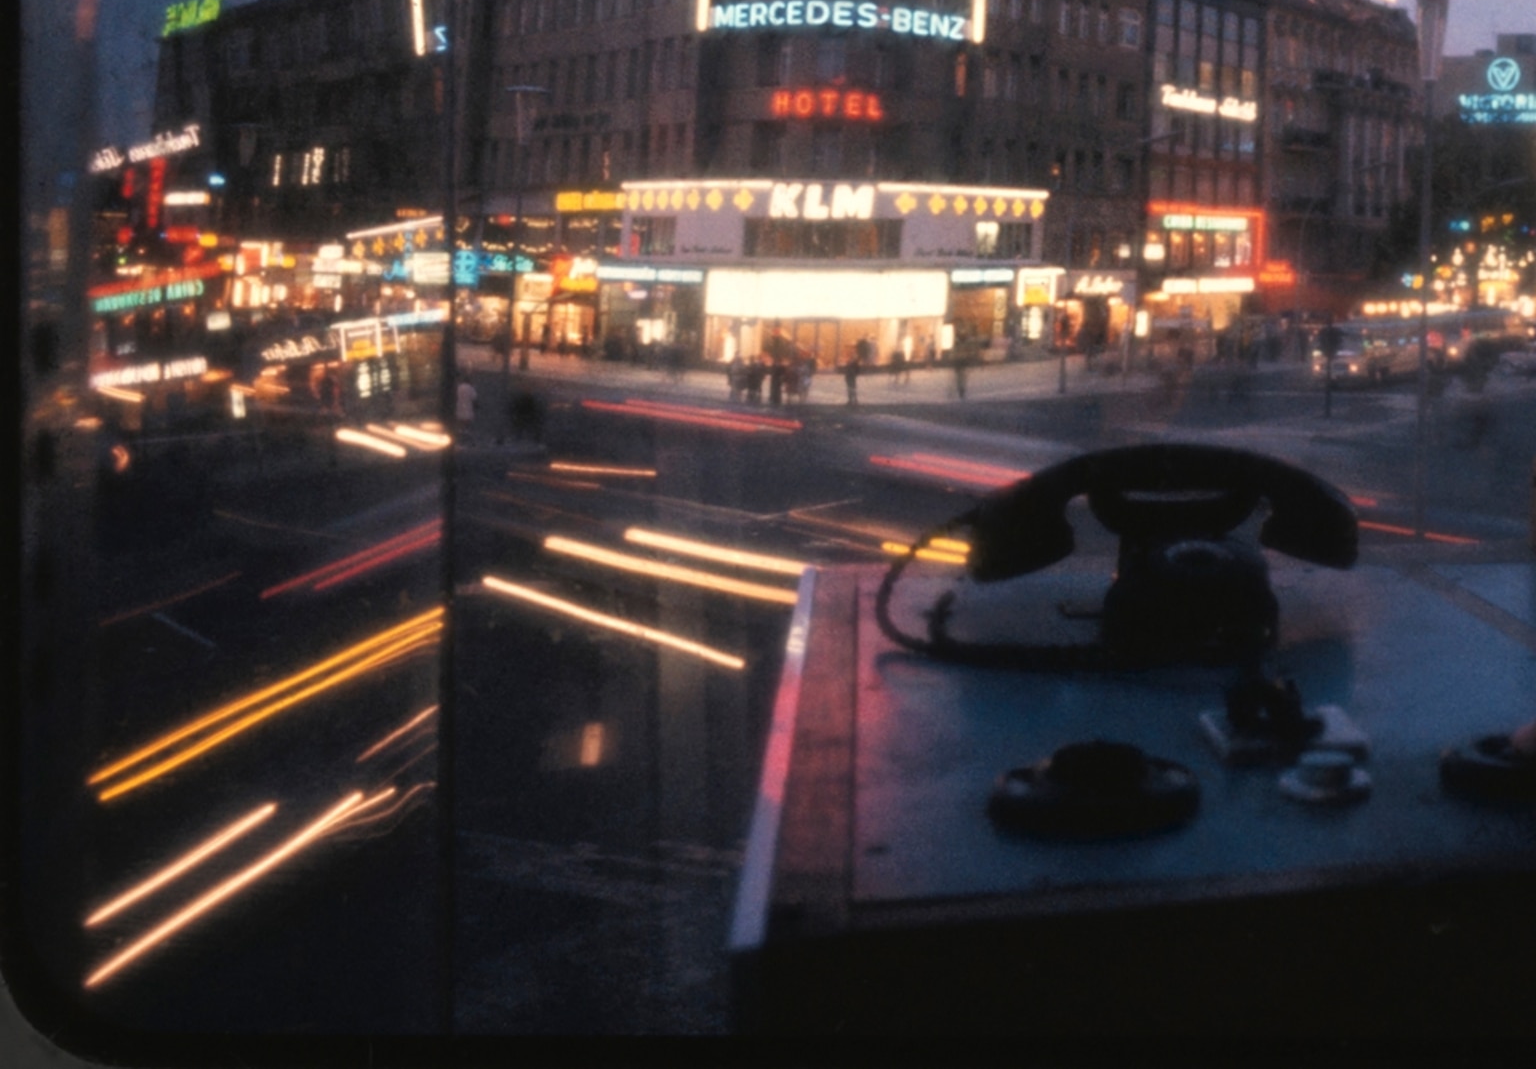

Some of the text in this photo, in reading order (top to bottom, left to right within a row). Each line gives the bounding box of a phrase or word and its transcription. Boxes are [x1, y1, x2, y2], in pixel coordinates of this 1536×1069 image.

[713, 0, 966, 40] MERCEDES-BENZ
[771, 89, 883, 120] HOTEL
[768, 183, 875, 219] KLM
